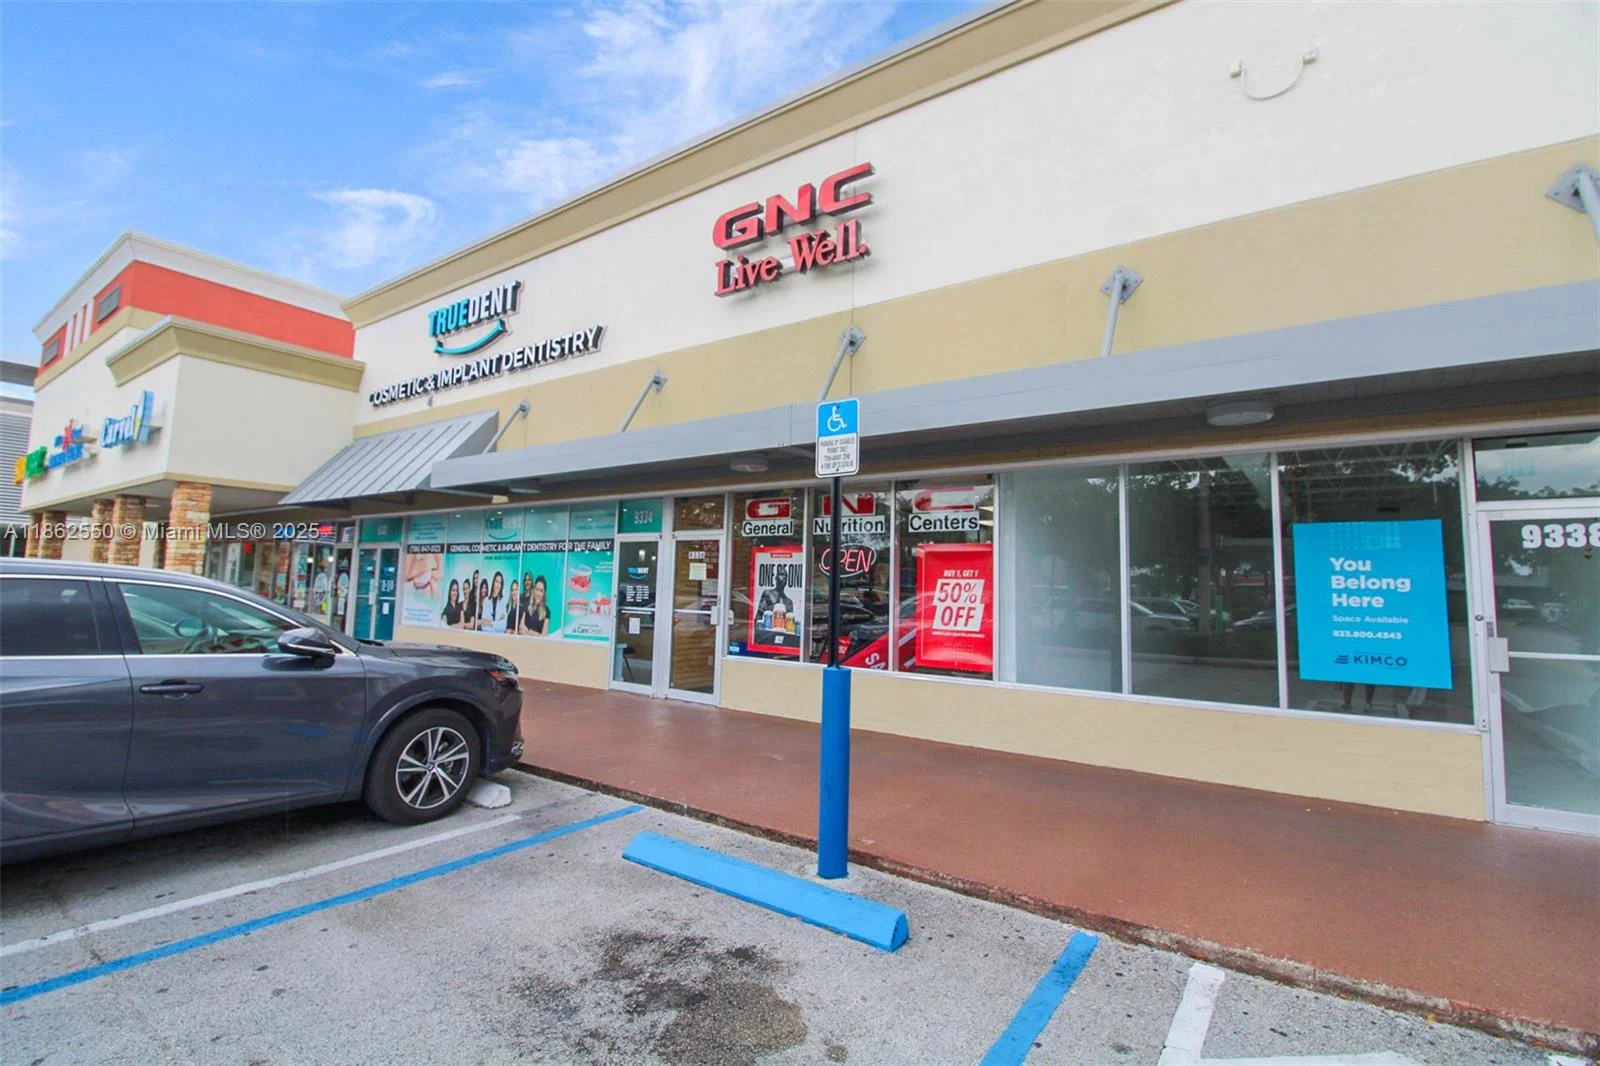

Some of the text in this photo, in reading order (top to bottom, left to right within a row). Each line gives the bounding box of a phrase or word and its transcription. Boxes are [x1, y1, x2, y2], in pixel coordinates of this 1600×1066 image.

[713, 162, 875, 249] GNC
[714, 218, 871, 297] Live Well.
[428, 280, 521, 338] TRUEDENT
[369, 325, 602, 407] COSMETIC & IMPLANT DENTISTRY
[743, 514, 979, 536] General Nurition Centers
[526, 542, 557, 551] DENTISTRY
[557, 542, 573, 551] FOR
[586, 540, 611, 550] FAMILY
[759, 563, 776, 587] ONE
[943, 569, 956, 577] BUY
[962, 569, 974, 577] GET
[974, 569, 979, 577] 1
[1329, 557, 1372, 572] You
[937, 582, 977, 604] 50%
[1331, 575, 1411, 593] Belong
[1331, 593, 1385, 608] Here
[940, 606, 976, 627] OFF
[1332, 614, 1409, 624] Space Available
[1353, 655, 1408, 667] KIMCO
